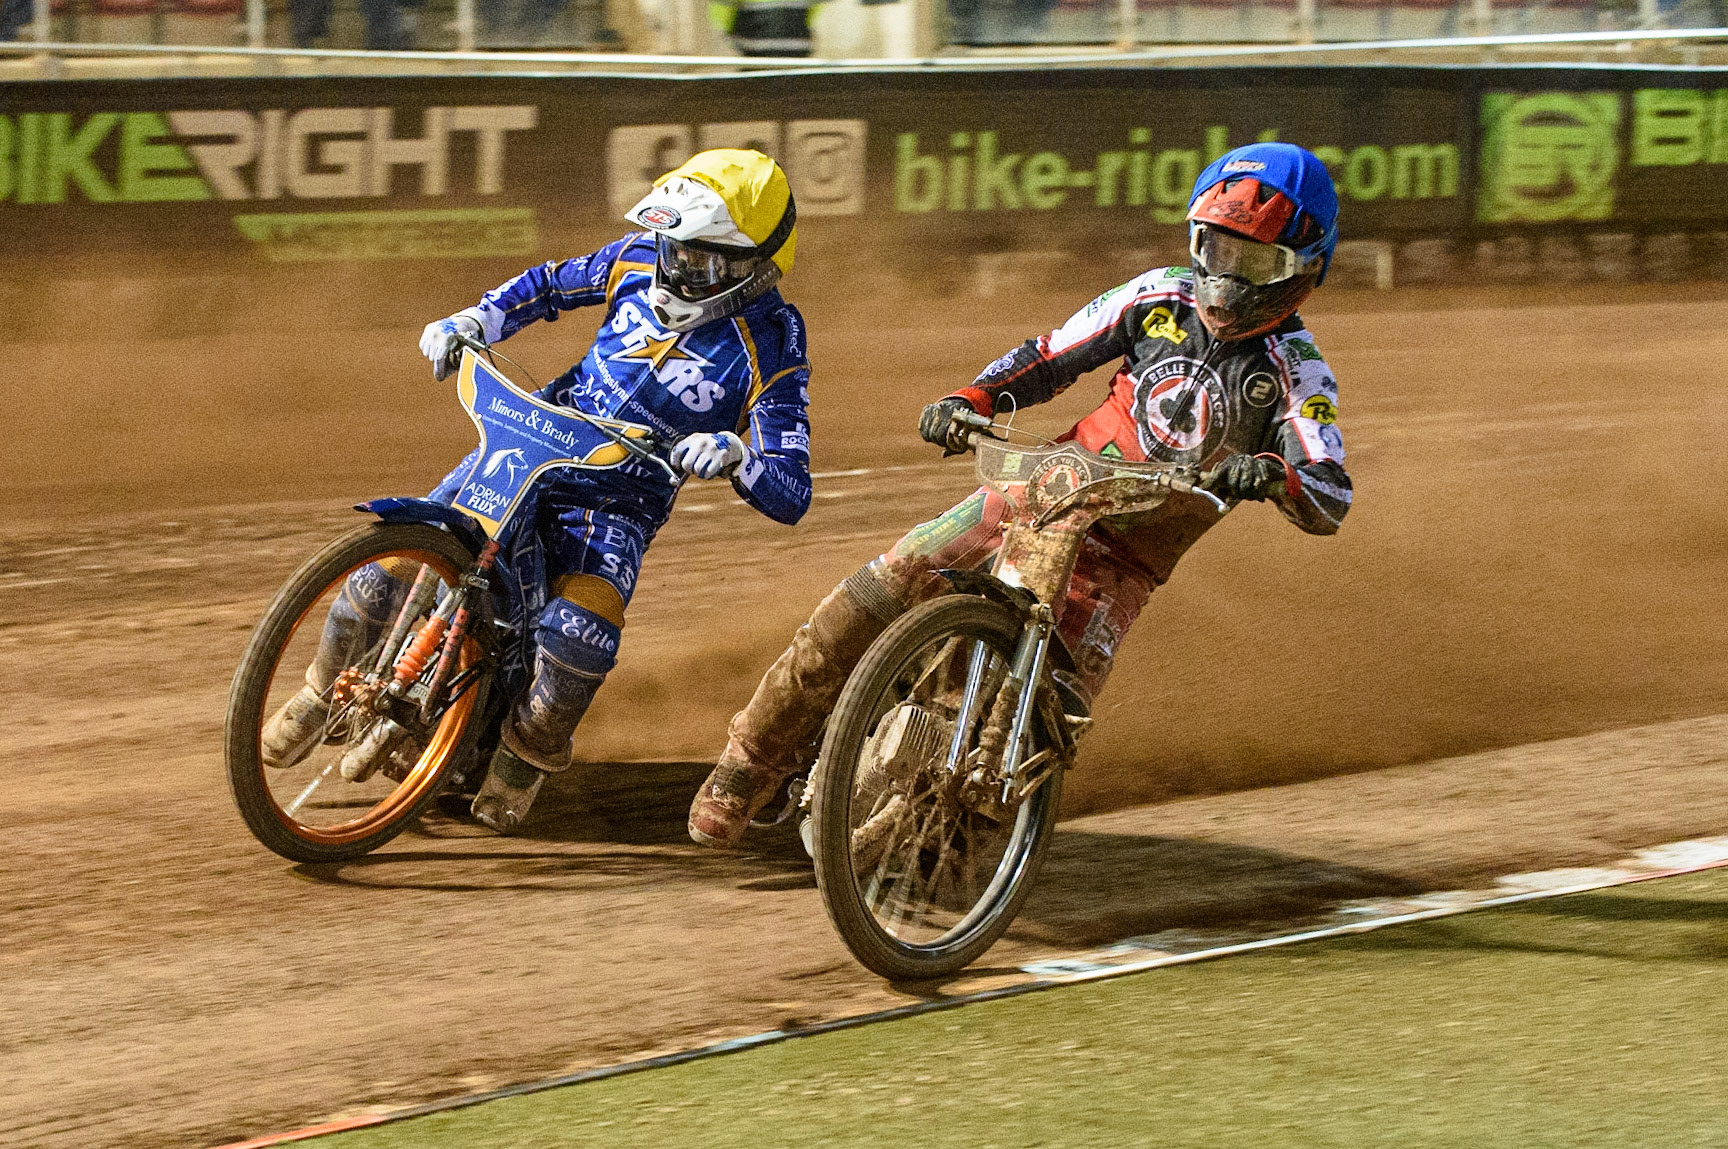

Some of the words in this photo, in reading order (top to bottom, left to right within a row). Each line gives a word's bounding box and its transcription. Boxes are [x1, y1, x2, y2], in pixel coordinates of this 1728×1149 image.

[1148, 363, 1186, 383] BELLE
[488, 397, 526, 423] Minors
[525, 409, 542, 430] &
[541, 420, 580, 449] Brady
[465, 481, 511, 509] ADRIAN
[467, 494, 499, 515] FLUX
[560, 608, 616, 651] Elite
